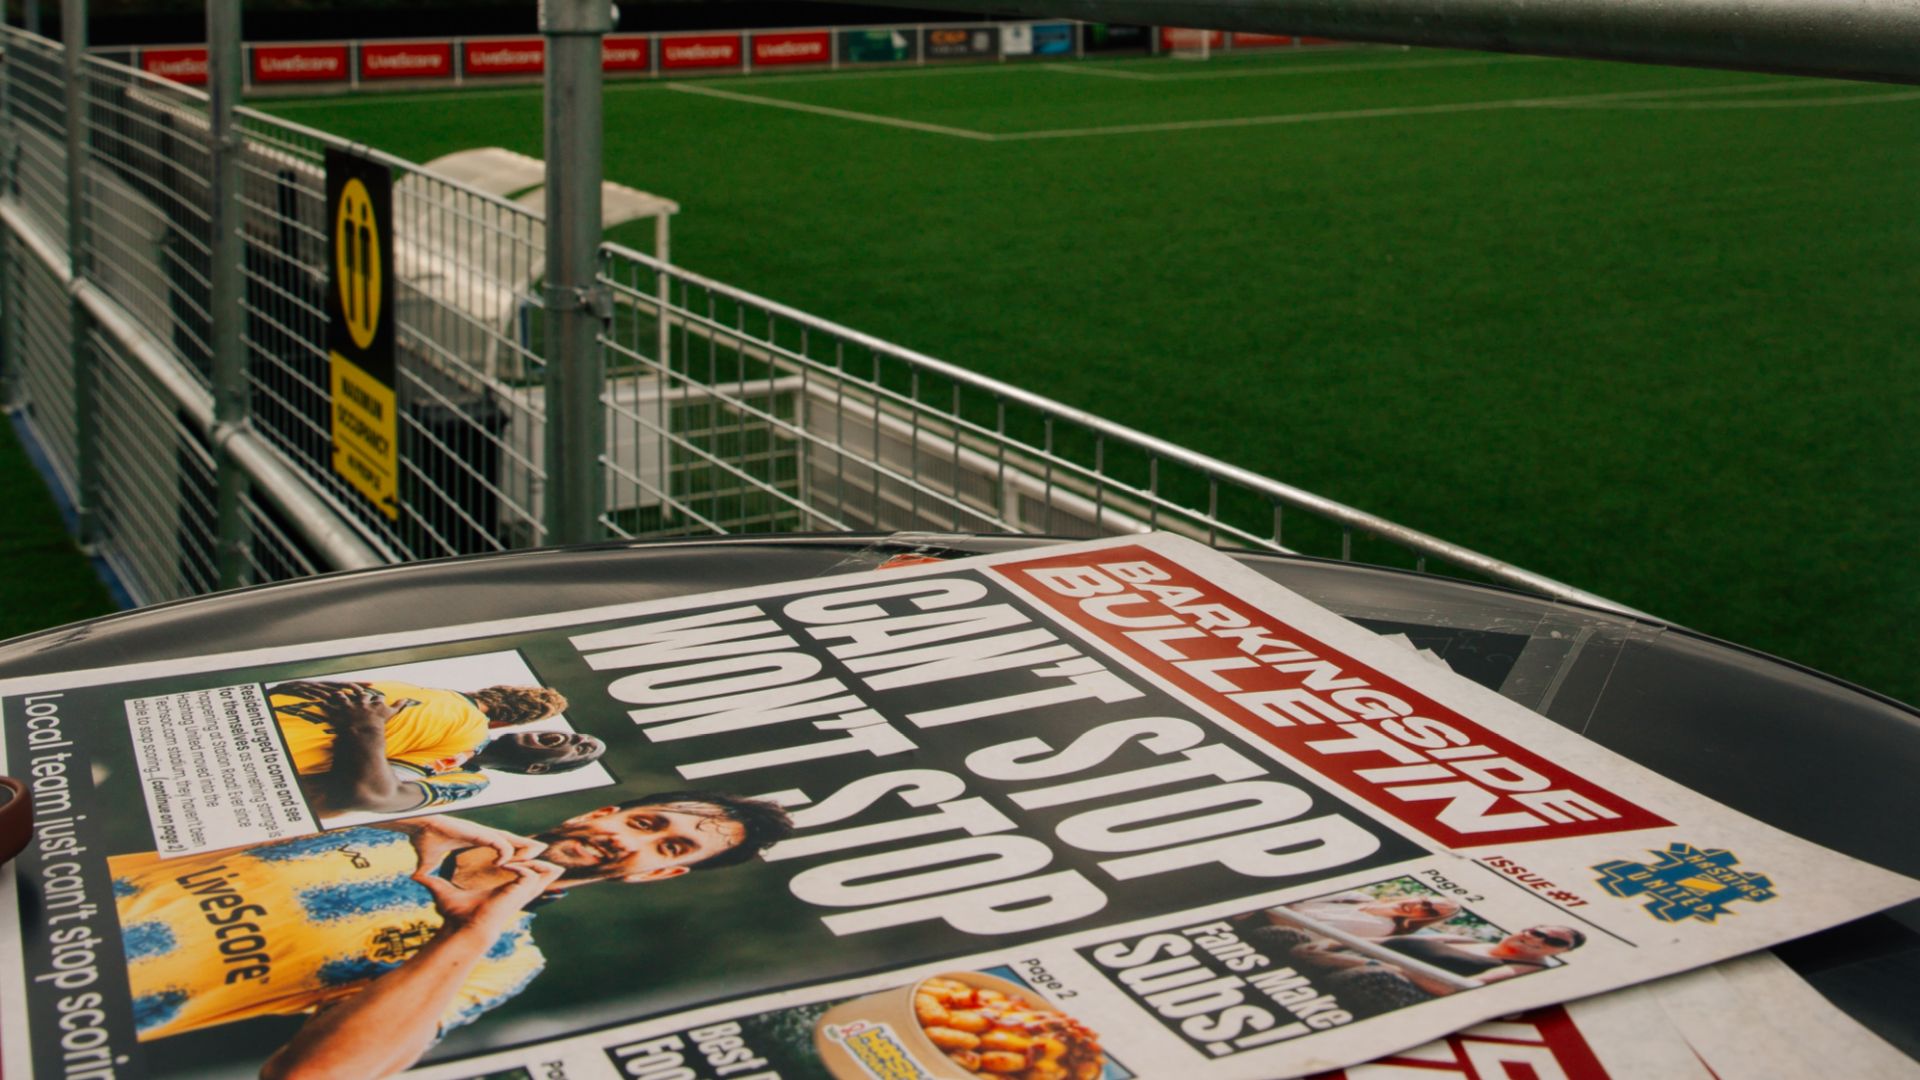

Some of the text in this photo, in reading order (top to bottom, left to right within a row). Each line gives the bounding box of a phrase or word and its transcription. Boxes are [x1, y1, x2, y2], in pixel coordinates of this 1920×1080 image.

[260, 55, 338, 73] LiveScore
[367, 52, 442, 70] LiveScore
[470, 49, 542, 66] LiveScore
[665, 43, 734, 61] LiveScore
[756, 41, 822, 58] LiveScore
[133, 699, 147, 716] able
[197, 690, 219, 731] happening
[1022, 564, 1550, 834] BULLETIN
[1097, 560, 1623, 825] BARKINGSIDE
[24, 693, 73, 750] Local
[137, 716, 149, 725] to
[138, 725, 153, 743] stop
[209, 731, 223, 740] at
[782, 578, 1381, 881] CAN'T STOP
[177, 694, 219, 807] Hashtag United moved into the
[212, 740, 232, 767] Station
[218, 688, 284, 838] for themselves as something strange is
[240, 685, 302, 822] Residents urged to come and see
[568, 605, 1108, 937] WON'T STOP
[31, 752, 72, 815] team
[228, 790, 247, 807] Ever
[157, 824, 178, 844] page
[160, 812, 173, 824] on
[175, 779, 192, 797] they
[190, 826, 206, 847] been
[234, 807, 252, 827] since
[33, 815, 87, 860] just
[42, 861, 98, 925] can't
[1420, 868, 1485, 903] Page 2
[1482, 855, 1590, 907] ISSUE #1
[1627, 871, 1714, 912] UNITED
[1684, 854, 1768, 898] HASHTAG
[175, 864, 270, 985] LiveScore
[34, 926, 103, 989] stop
[1019, 958, 1078, 1000] Page 2
[1181, 921, 1353, 1029] Fans Make
[1093, 933, 1312, 1057] Subs!
[687, 1021, 769, 1076] Best
